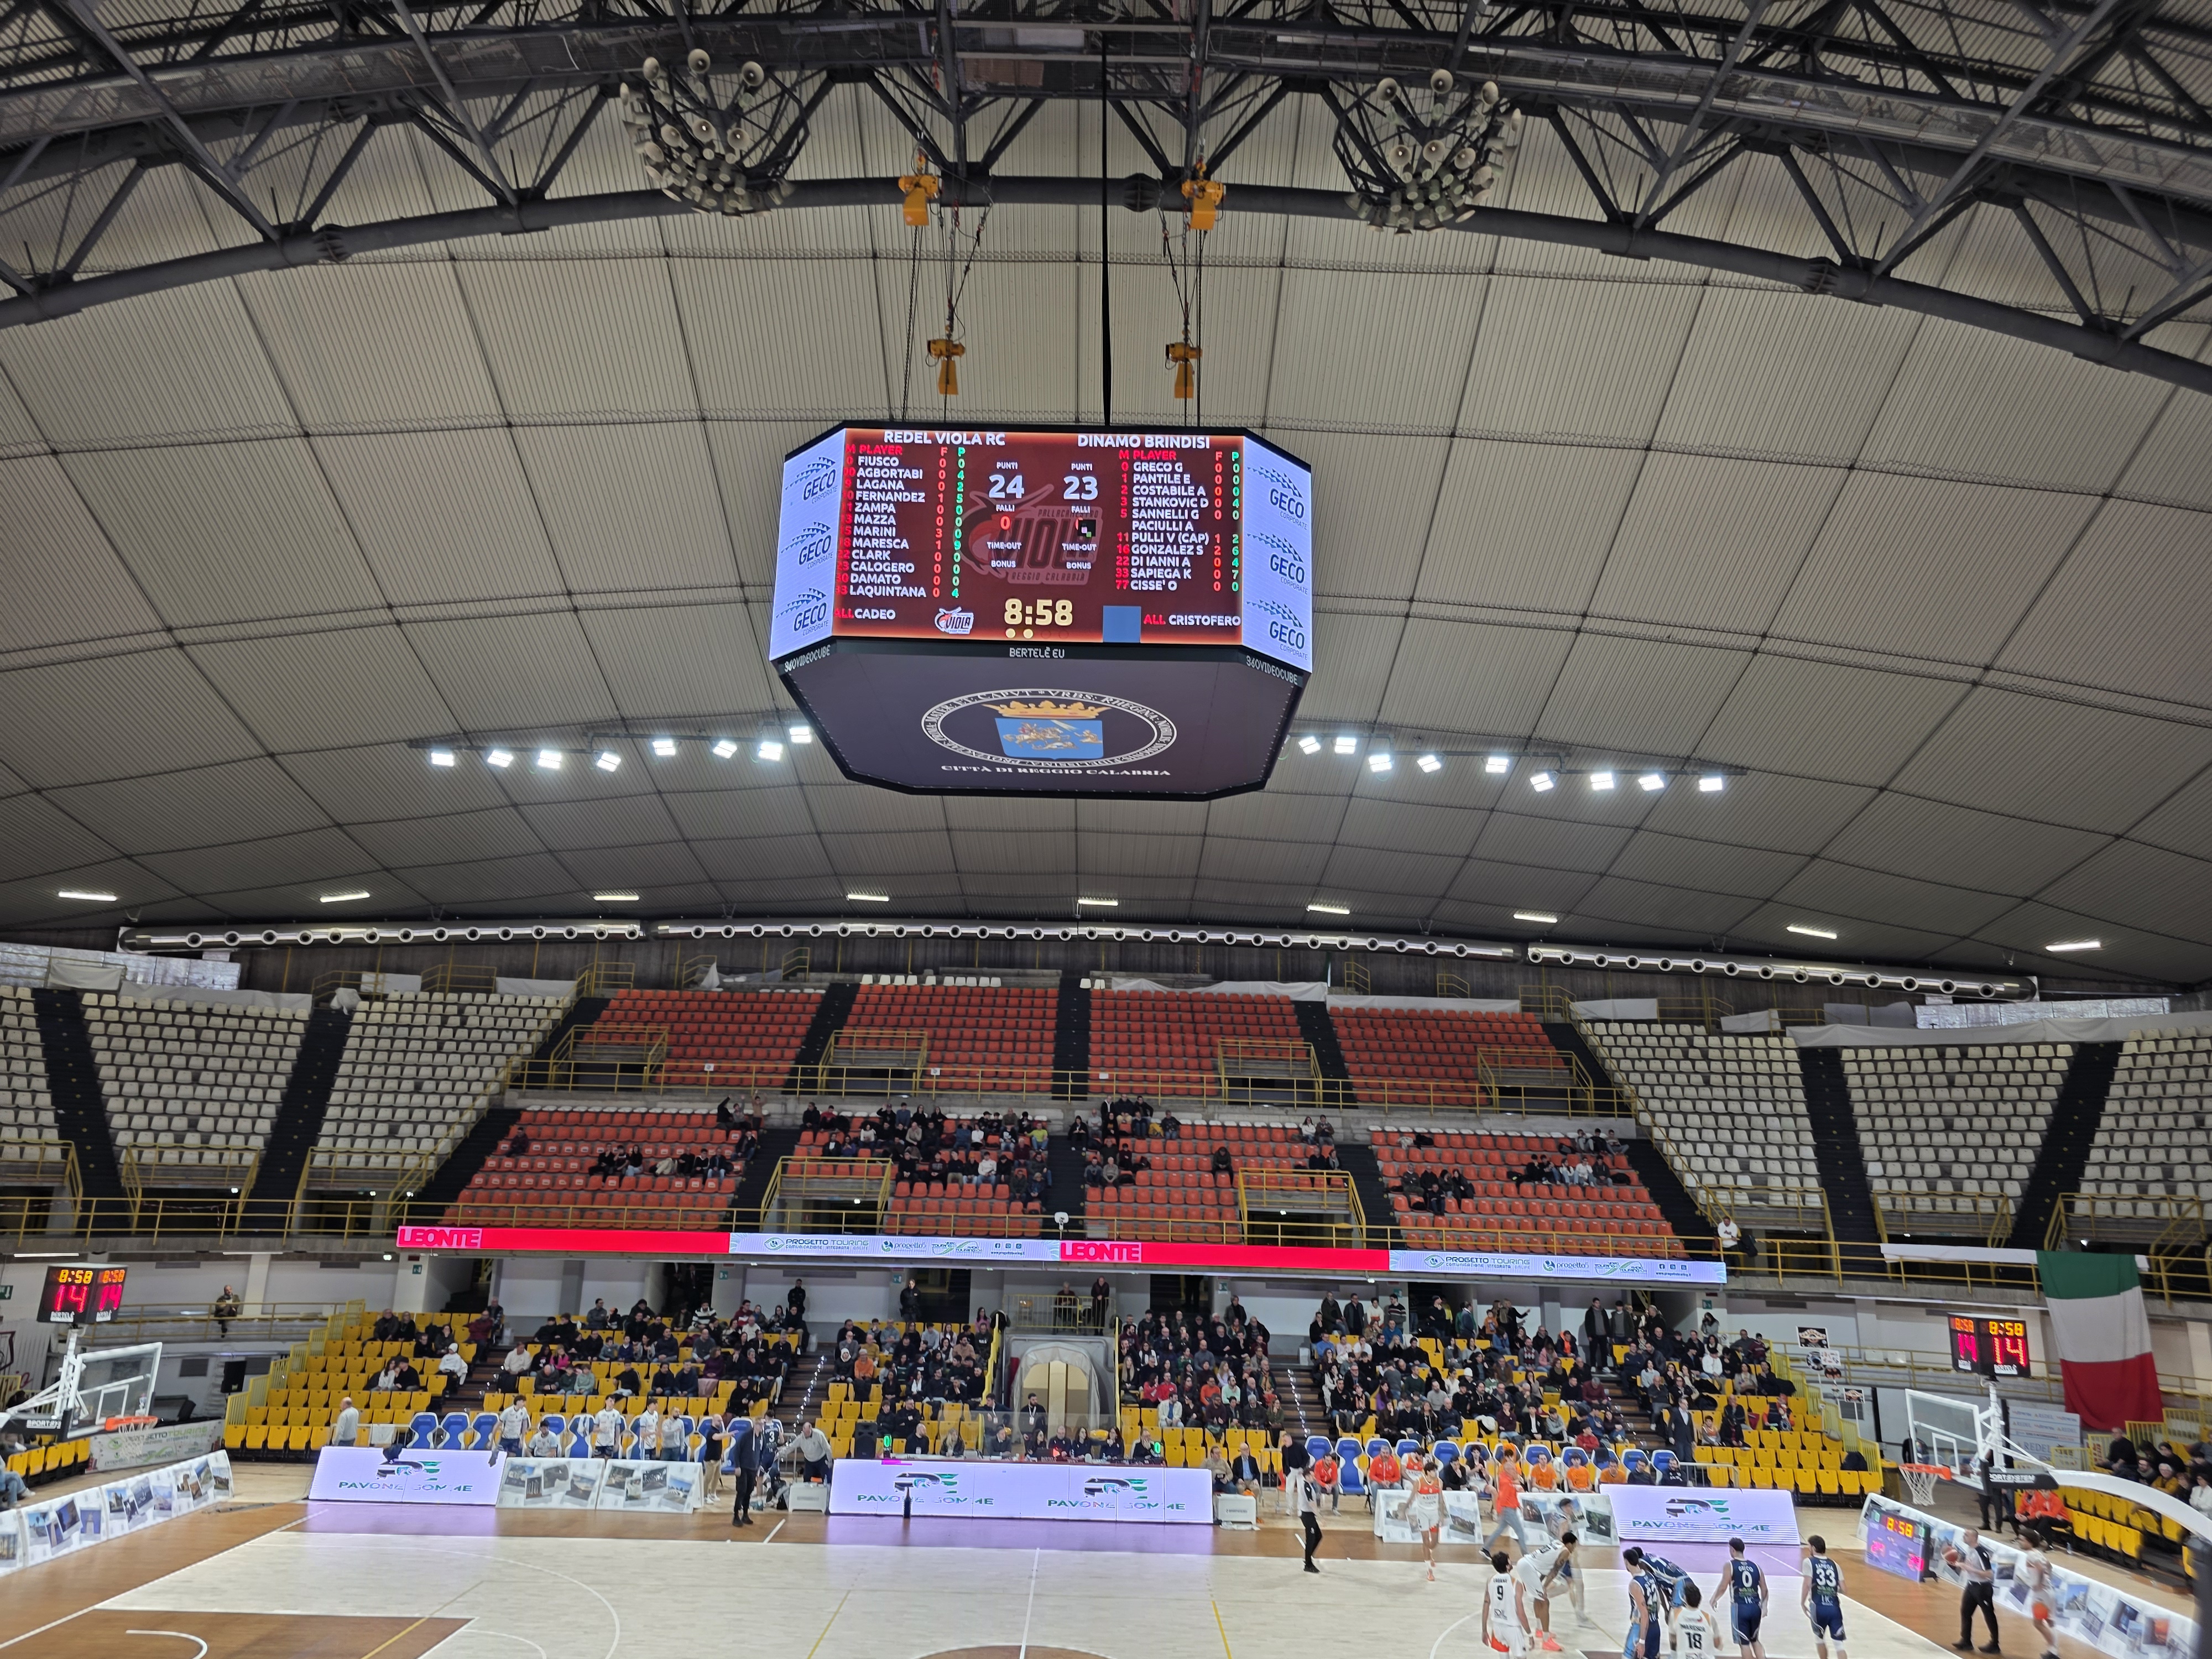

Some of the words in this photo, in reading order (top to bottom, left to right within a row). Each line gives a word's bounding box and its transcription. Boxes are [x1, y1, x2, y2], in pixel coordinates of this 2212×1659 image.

[884, 431, 932, 444] REDEL
[935, 432, 983, 445] VIOLA
[986, 433, 1005, 446] RC
[1078, 435, 1141, 448] DINAMO
[1145, 435, 1210, 448] BRINDISI
[859, 444, 903, 455] PLAYER
[940, 447, 948, 457] F
[958, 447, 966, 457] P
[1119, 450, 1130, 460] M
[1133, 450, 1177, 461] PLAYER
[1215, 451, 1223, 461] F
[1232, 451, 1239, 461] P
[858, 456, 899, 467] FIUSCO
[958, 458, 966, 468] 0
[997, 462, 1018, 470] PUNTI
[1071, 463, 1093, 471] PUNTI
[1121, 461, 1129, 471] 0
[1134, 462, 1172, 472] GRECO
[1175, 462, 1183, 472] G
[1233, 463, 1240, 473] 0
[857, 467, 923, 479] AGBORTABI
[957, 470, 964, 480] 4
[1121, 473, 1128, 483] 1
[1133, 473, 1181, 484] PANTILE
[1183, 474, 1191, 484] E
[1233, 475, 1240, 484] 0
[803, 469, 836, 501] GECO
[856, 479, 905, 490] LAGANA
[957, 482, 964, 492] 2
[989, 474, 1024, 499] 24
[1063, 476, 1098, 500] 23
[1121, 485, 1128, 495] 2
[1133, 485, 1194, 496] COSTABILE
[1197, 486, 1206, 497] A
[1233, 487, 1240, 497] 0
[811, 485, 838, 504] CORPORATE
[855, 491, 925, 502] FERNANDEZ
[938, 493, 943, 503] 1
[956, 493, 963, 504] 5
[854, 502, 896, 513] ZAMPA
[956, 505, 963, 515] 0
[1071, 505, 1091, 514] FALLI
[1120, 497, 1128, 507] 3
[1132, 497, 1198, 508] STANKOVIC
[1200, 498, 1209, 508] D
[1232, 499, 1240, 509] 4
[1270, 488, 1305, 519] GECO
[854, 514, 896, 525] MAZZA
[955, 517, 962, 527] 0
[1120, 509, 1128, 518] 5
[1132, 509, 1188, 520] SANNELLI
[1191, 510, 1199, 520] G
[1232, 510, 1239, 520] 0
[1280, 510, 1307, 530] CORPORATE
[1000, 515, 1011, 530] 0
[1132, 520, 1182, 531] PACIULLI
[1185, 521, 1194, 531] A
[853, 525, 896, 536] MARINI
[936, 528, 942, 538] 3
[954, 529, 962, 539] 0
[1117, 532, 1129, 542] 11
[1131, 532, 1164, 543] PULLI
[1166, 533, 1176, 543] V
[1178, 532, 1209, 545] (CAP)
[1214, 534, 1220, 543] 1
[1232, 534, 1239, 544] 2
[799, 534, 832, 565] GECO
[853, 538, 909, 549] MARESCA
[936, 540, 941, 550] 1
[987, 541, 1022, 550] TIME-OUT
[1062, 543, 1097, 551] TIME-OUT
[1117, 544, 1130, 554] 16
[1131, 544, 1194, 555] GONZALEZ
[1196, 545, 1204, 555] S
[1214, 545, 1221, 555] 2
[1232, 546, 1239, 556] 6
[807, 551, 834, 570] CORPORATE
[852, 549, 890, 560] CLARK
[953, 552, 961, 562] 0
[1116, 556, 1129, 566] 22
[1131, 556, 1143, 566] DI
[1146, 556, 1179, 567] IANNI
[1181, 557, 1191, 567] A
[1232, 557, 1239, 567] 4
[851, 561, 915, 573] CALOGERO
[953, 564, 960, 575] 0
[991, 560, 1016, 568] BONUS
[1270, 553, 1305, 585] GECO
[851, 573, 901, 585] DAMATO
[952, 576, 959, 586] 0
[1011, 572, 1041, 581] REGGIO
[1045, 572, 1086, 582] CALABRIA
[1115, 567, 1129, 578] 33
[1130, 567, 1181, 579] SAPIEGA
[1183, 568, 1192, 579] K
[1232, 570, 1239, 580] 7
[849, 585, 927, 598] LAQUINTANA
[952, 588, 959, 598] 4
[1115, 580, 1129, 590] 77
[1130, 580, 1166, 591] CISSE'
[1168, 581, 1177, 591] O
[1232, 582, 1239, 592] 0
[1280, 576, 1308, 596] CORPORATE
[794, 602, 827, 632] GECO
[834, 608, 854, 619] ALL
[854, 609, 896, 620] CADEO
[1004, 598, 1073, 626] 8:58
[945, 616, 971, 629] VIOLA
[1144, 614, 1166, 625] ALL
[1168, 614, 1241, 626] CRISTOFERO
[802, 619, 829, 636] CORPORATE
[1270, 620, 1305, 650] GECO
[1052, 648, 1065, 659] EU
[1280, 643, 1308, 661] CORPORATE
[399, 1228, 479, 1247] LEONTE
[1061, 1242, 1140, 1261] LEONTE
[59, 1270, 93, 1284] 8:58
[102, 1270, 125, 1284] 8:58
[55, 1284, 88, 1313] 14
[98, 1284, 122, 1311] 14
[1955, 1318, 1974, 1333] 8:58
[1989, 1321, 2024, 1337] 8:58
[1958, 1333, 1977, 1363] 14
[1994, 1337, 2026, 1367] 14
[769, 1431, 775, 1443] 3
[1886, 1517, 1914, 1538] 8:58
[1742, 1571, 1753, 1588] 0
[1816, 1568, 1837, 1588] 33
[1496, 1585, 1503, 1600] 9
[1686, 1632, 1702, 1650] 18
